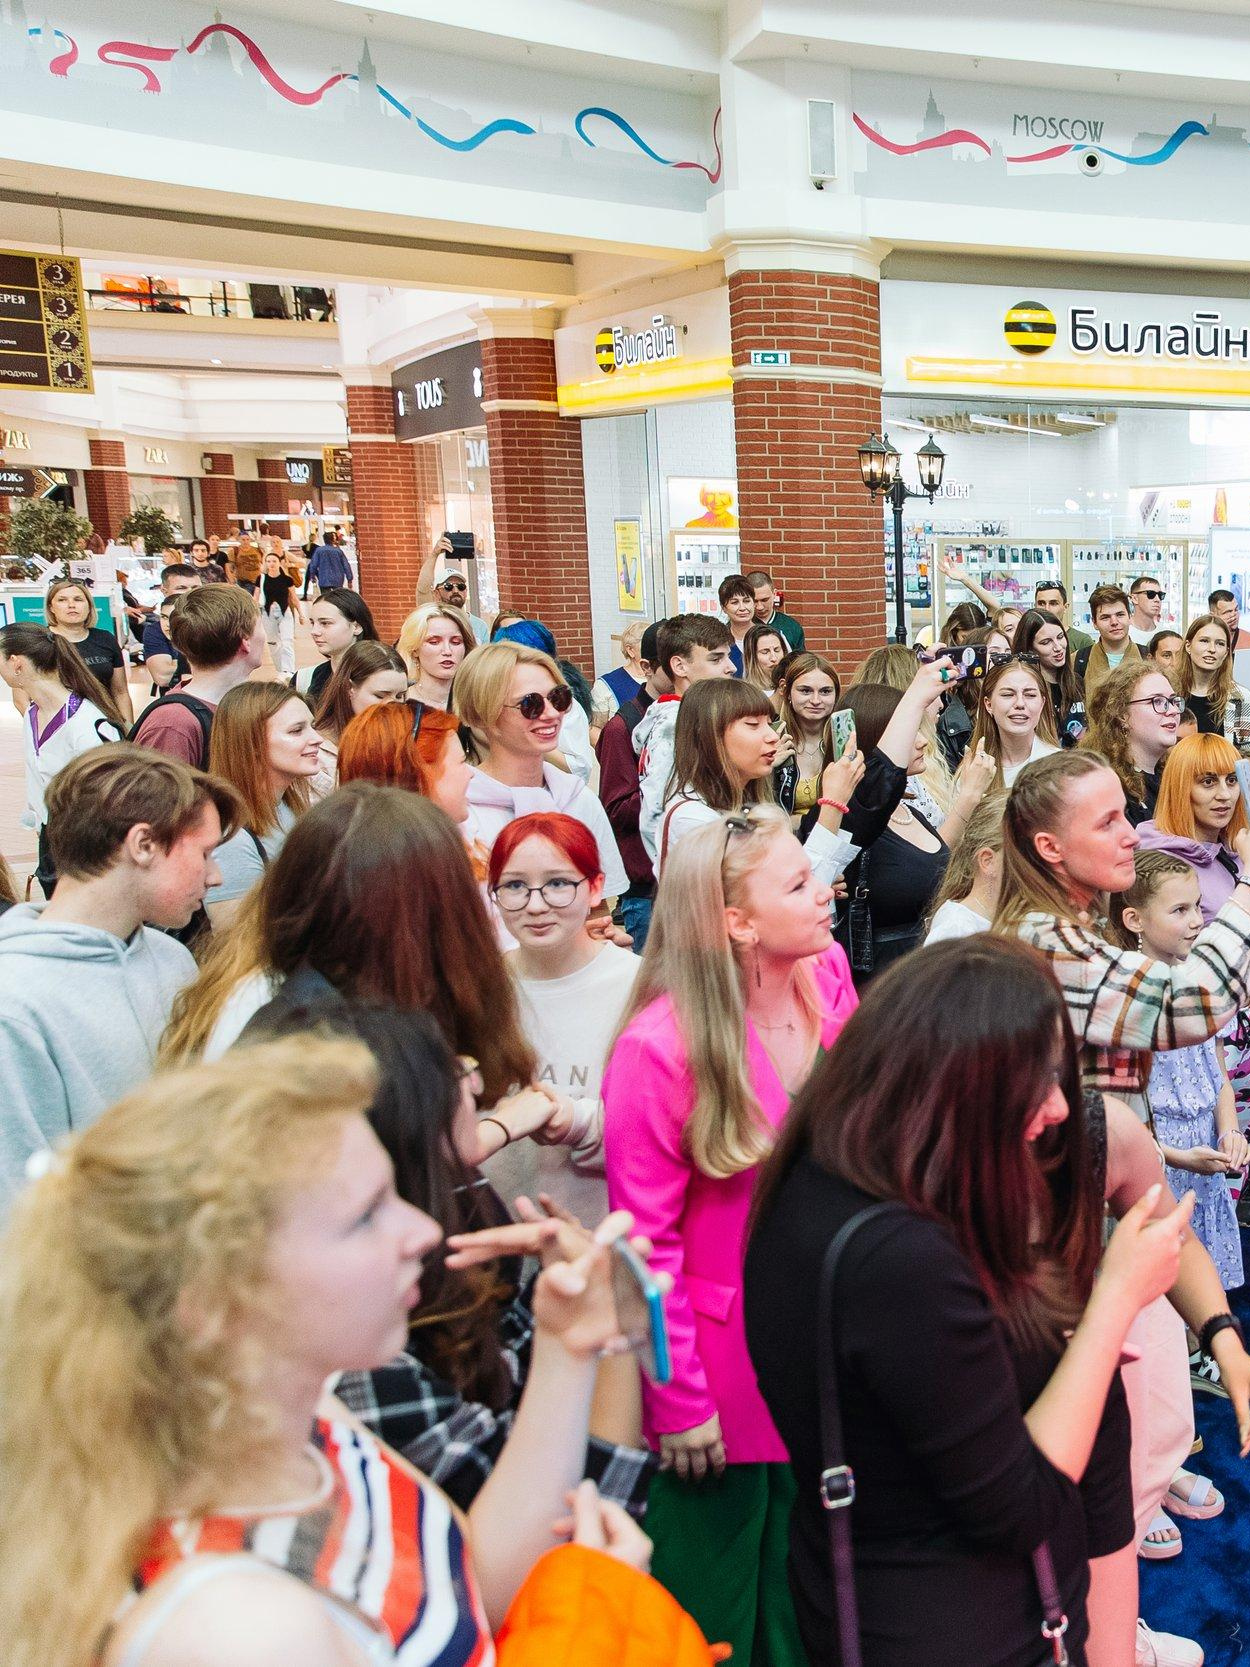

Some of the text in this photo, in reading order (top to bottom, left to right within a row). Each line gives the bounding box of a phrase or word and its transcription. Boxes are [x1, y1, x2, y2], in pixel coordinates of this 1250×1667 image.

[1012, 114, 1104, 142] MOSCOW
[52, 264, 63, 280] 3
[56, 297, 67, 313] 3
[60, 330, 72, 345] 2
[613, 316, 677, 368] Билайн
[63, 362, 73, 377] 1
[415, 378, 442, 410] TOUS
[5, 430, 31, 449] ZARA
[144, 447, 168, 464] ZARA
